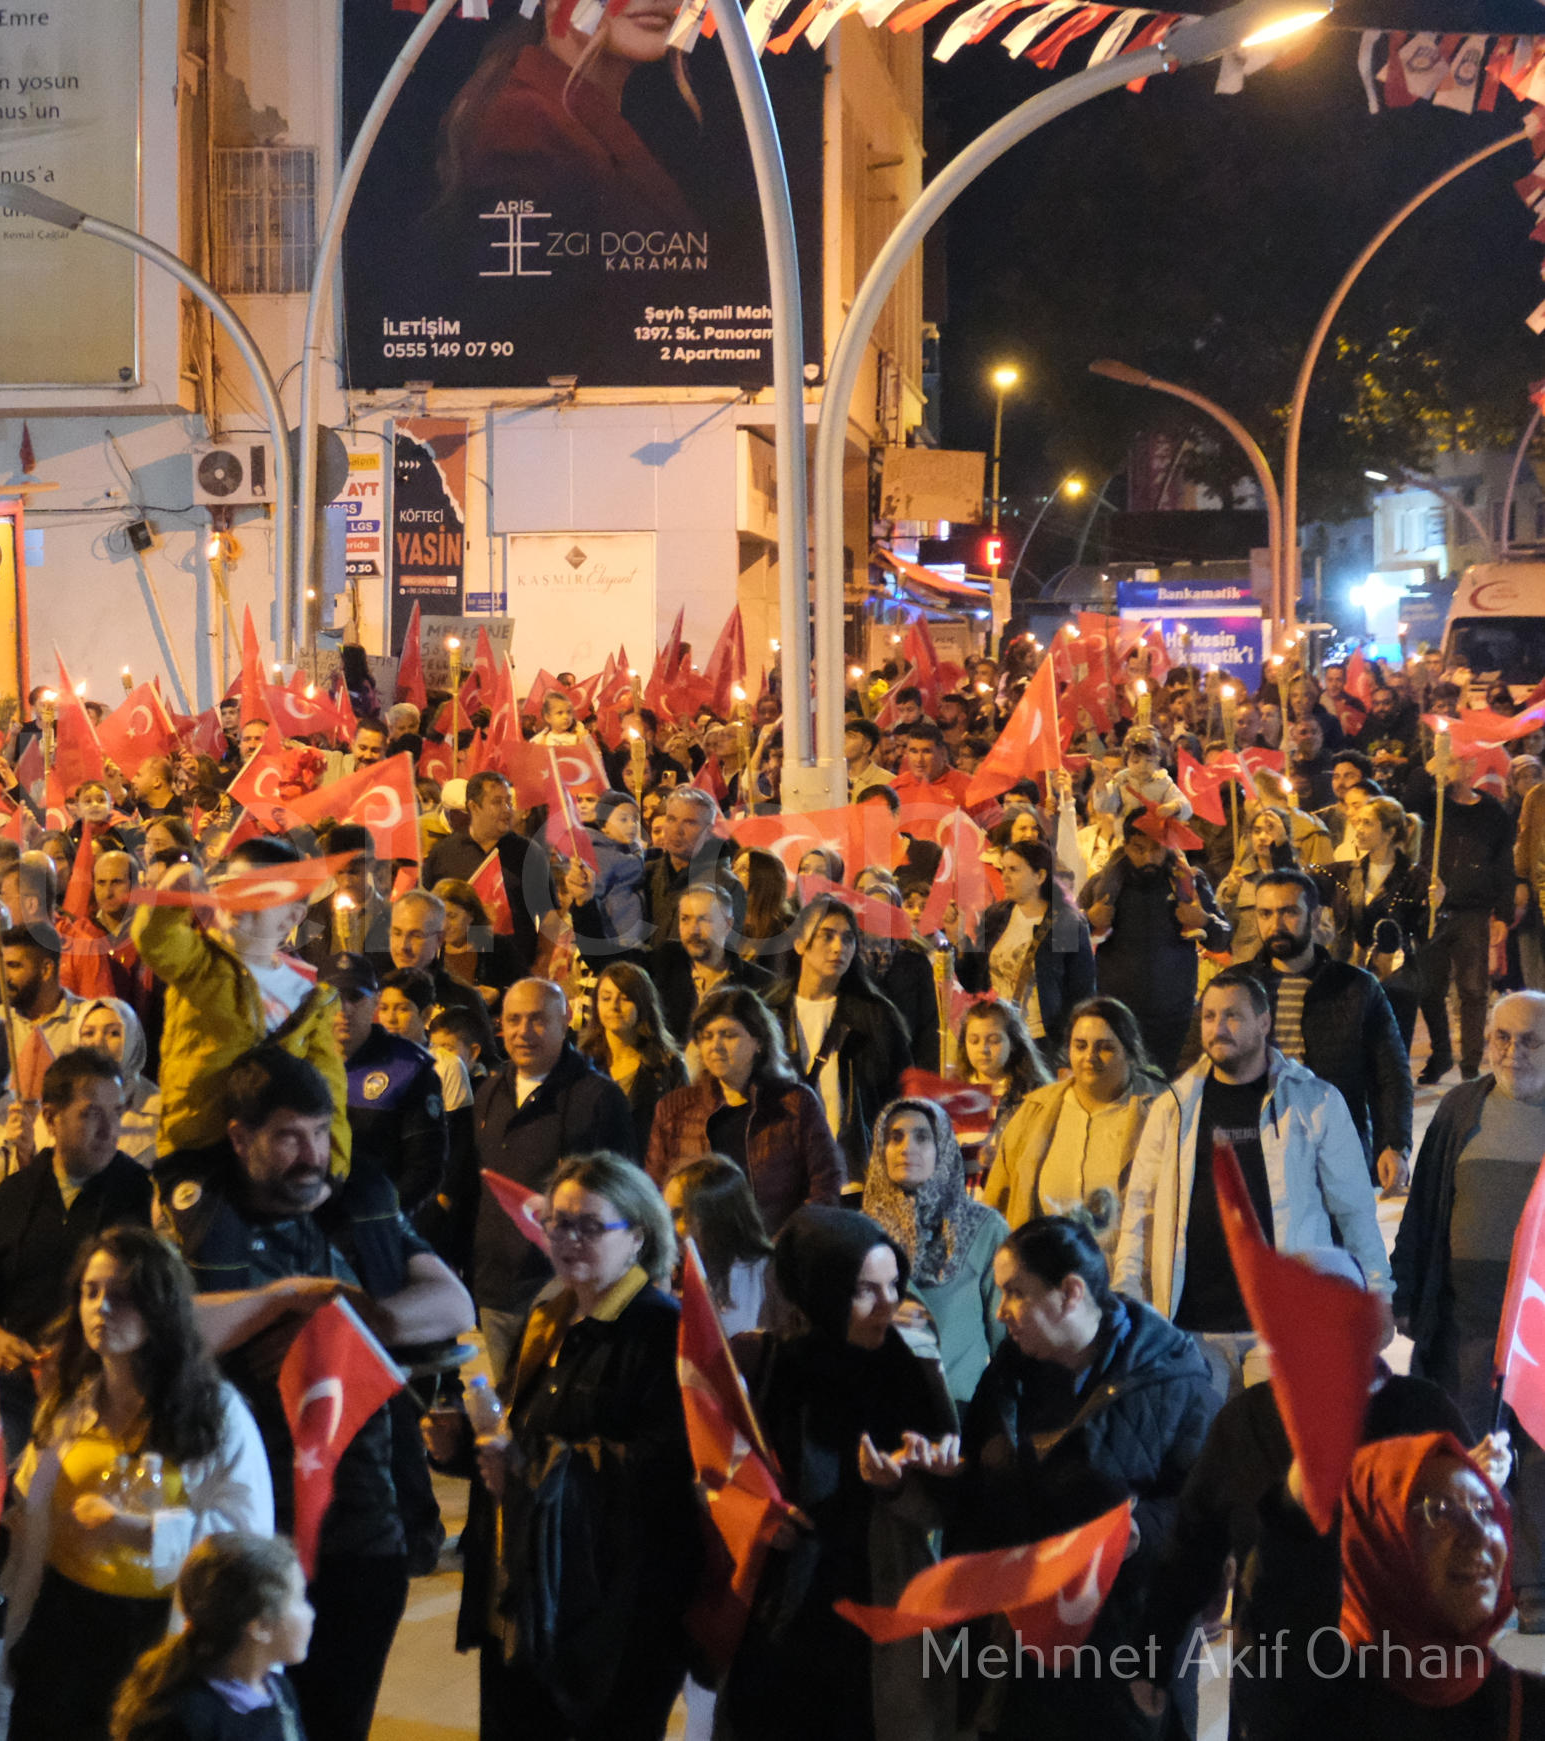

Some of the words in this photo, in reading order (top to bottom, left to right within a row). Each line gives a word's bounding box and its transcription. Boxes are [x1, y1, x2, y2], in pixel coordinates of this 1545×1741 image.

[18, 75, 79, 94] yosun
[3, 230, 35, 240] Kemal
[606, 256, 708, 271] KARAMAN
[645, 306, 684, 324] Şeyh
[688, 305, 733, 324] Şamil
[383, 316, 461, 340] İLETİŞİM
[634, 326, 672, 341] 1397.
[676, 326, 701, 340] Sk.
[383, 342, 427, 358] 0555
[431, 342, 461, 357] 149
[465, 341, 487, 357] 07
[491, 341, 514, 357] 90
[660, 347, 671, 360] 2
[674, 347, 761, 364] Apartmanı
[347, 482, 379, 497] AYT
[399, 508, 444, 523] KÖFTECİ
[350, 521, 374, 532] LGS
[396, 524, 463, 567] YASİN
[1157, 586, 1241, 600] Bankamatik
